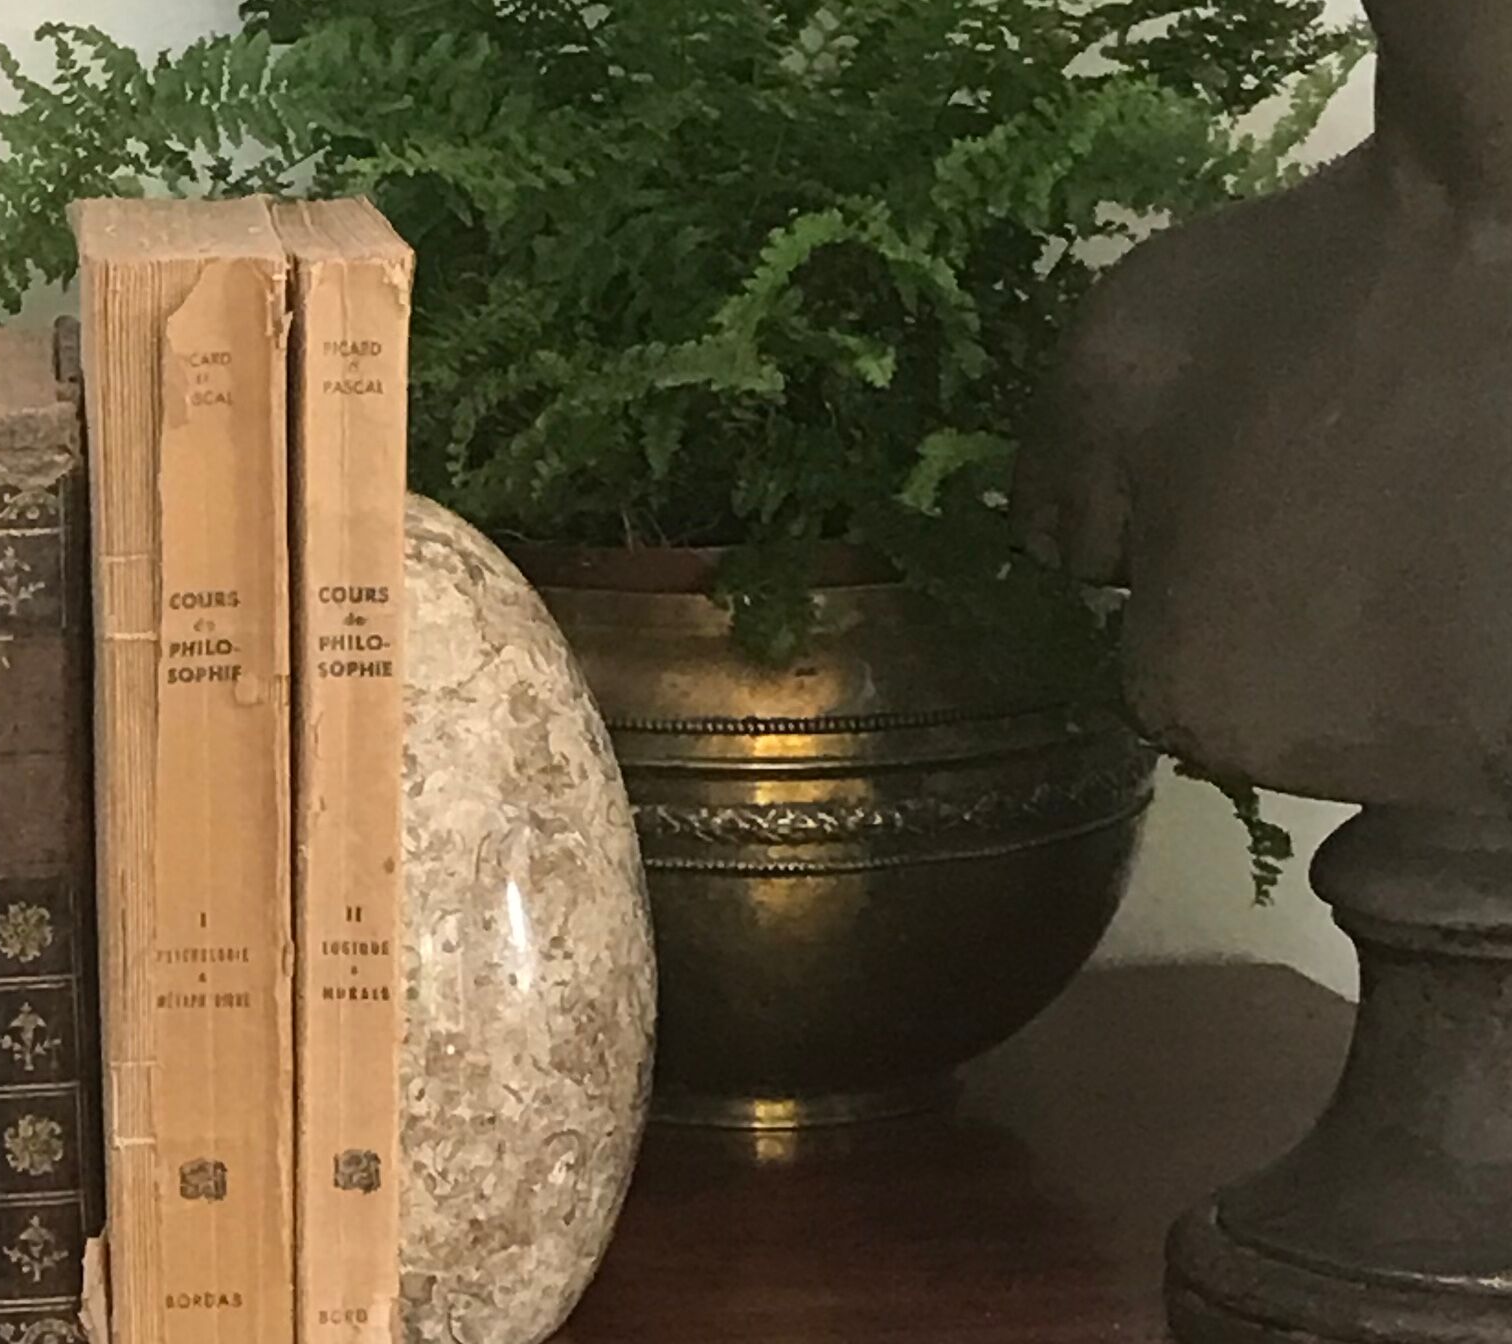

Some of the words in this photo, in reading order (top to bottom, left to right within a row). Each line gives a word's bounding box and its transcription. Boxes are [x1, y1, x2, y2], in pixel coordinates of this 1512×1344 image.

[188, 351, 232, 367] CARD
[323, 378, 384, 395] PASCAL
[191, 389, 235, 406] SCAL
[169, 590, 240, 610] COURS
[319, 586, 389, 604] COURS
[343, 612, 368, 627] de
[169, 639, 242, 658] PHILO-
[319, 634, 391, 652] PHILO-
[317, 660, 393, 678] SOPHIE
[346, 906, 362, 923] II
[322, 940, 390, 956] LOGIQUE
[322, 986, 391, 1002] MORALE
[165, 1291, 243, 1309] BORDAS
[319, 1308, 369, 1325] BORD
